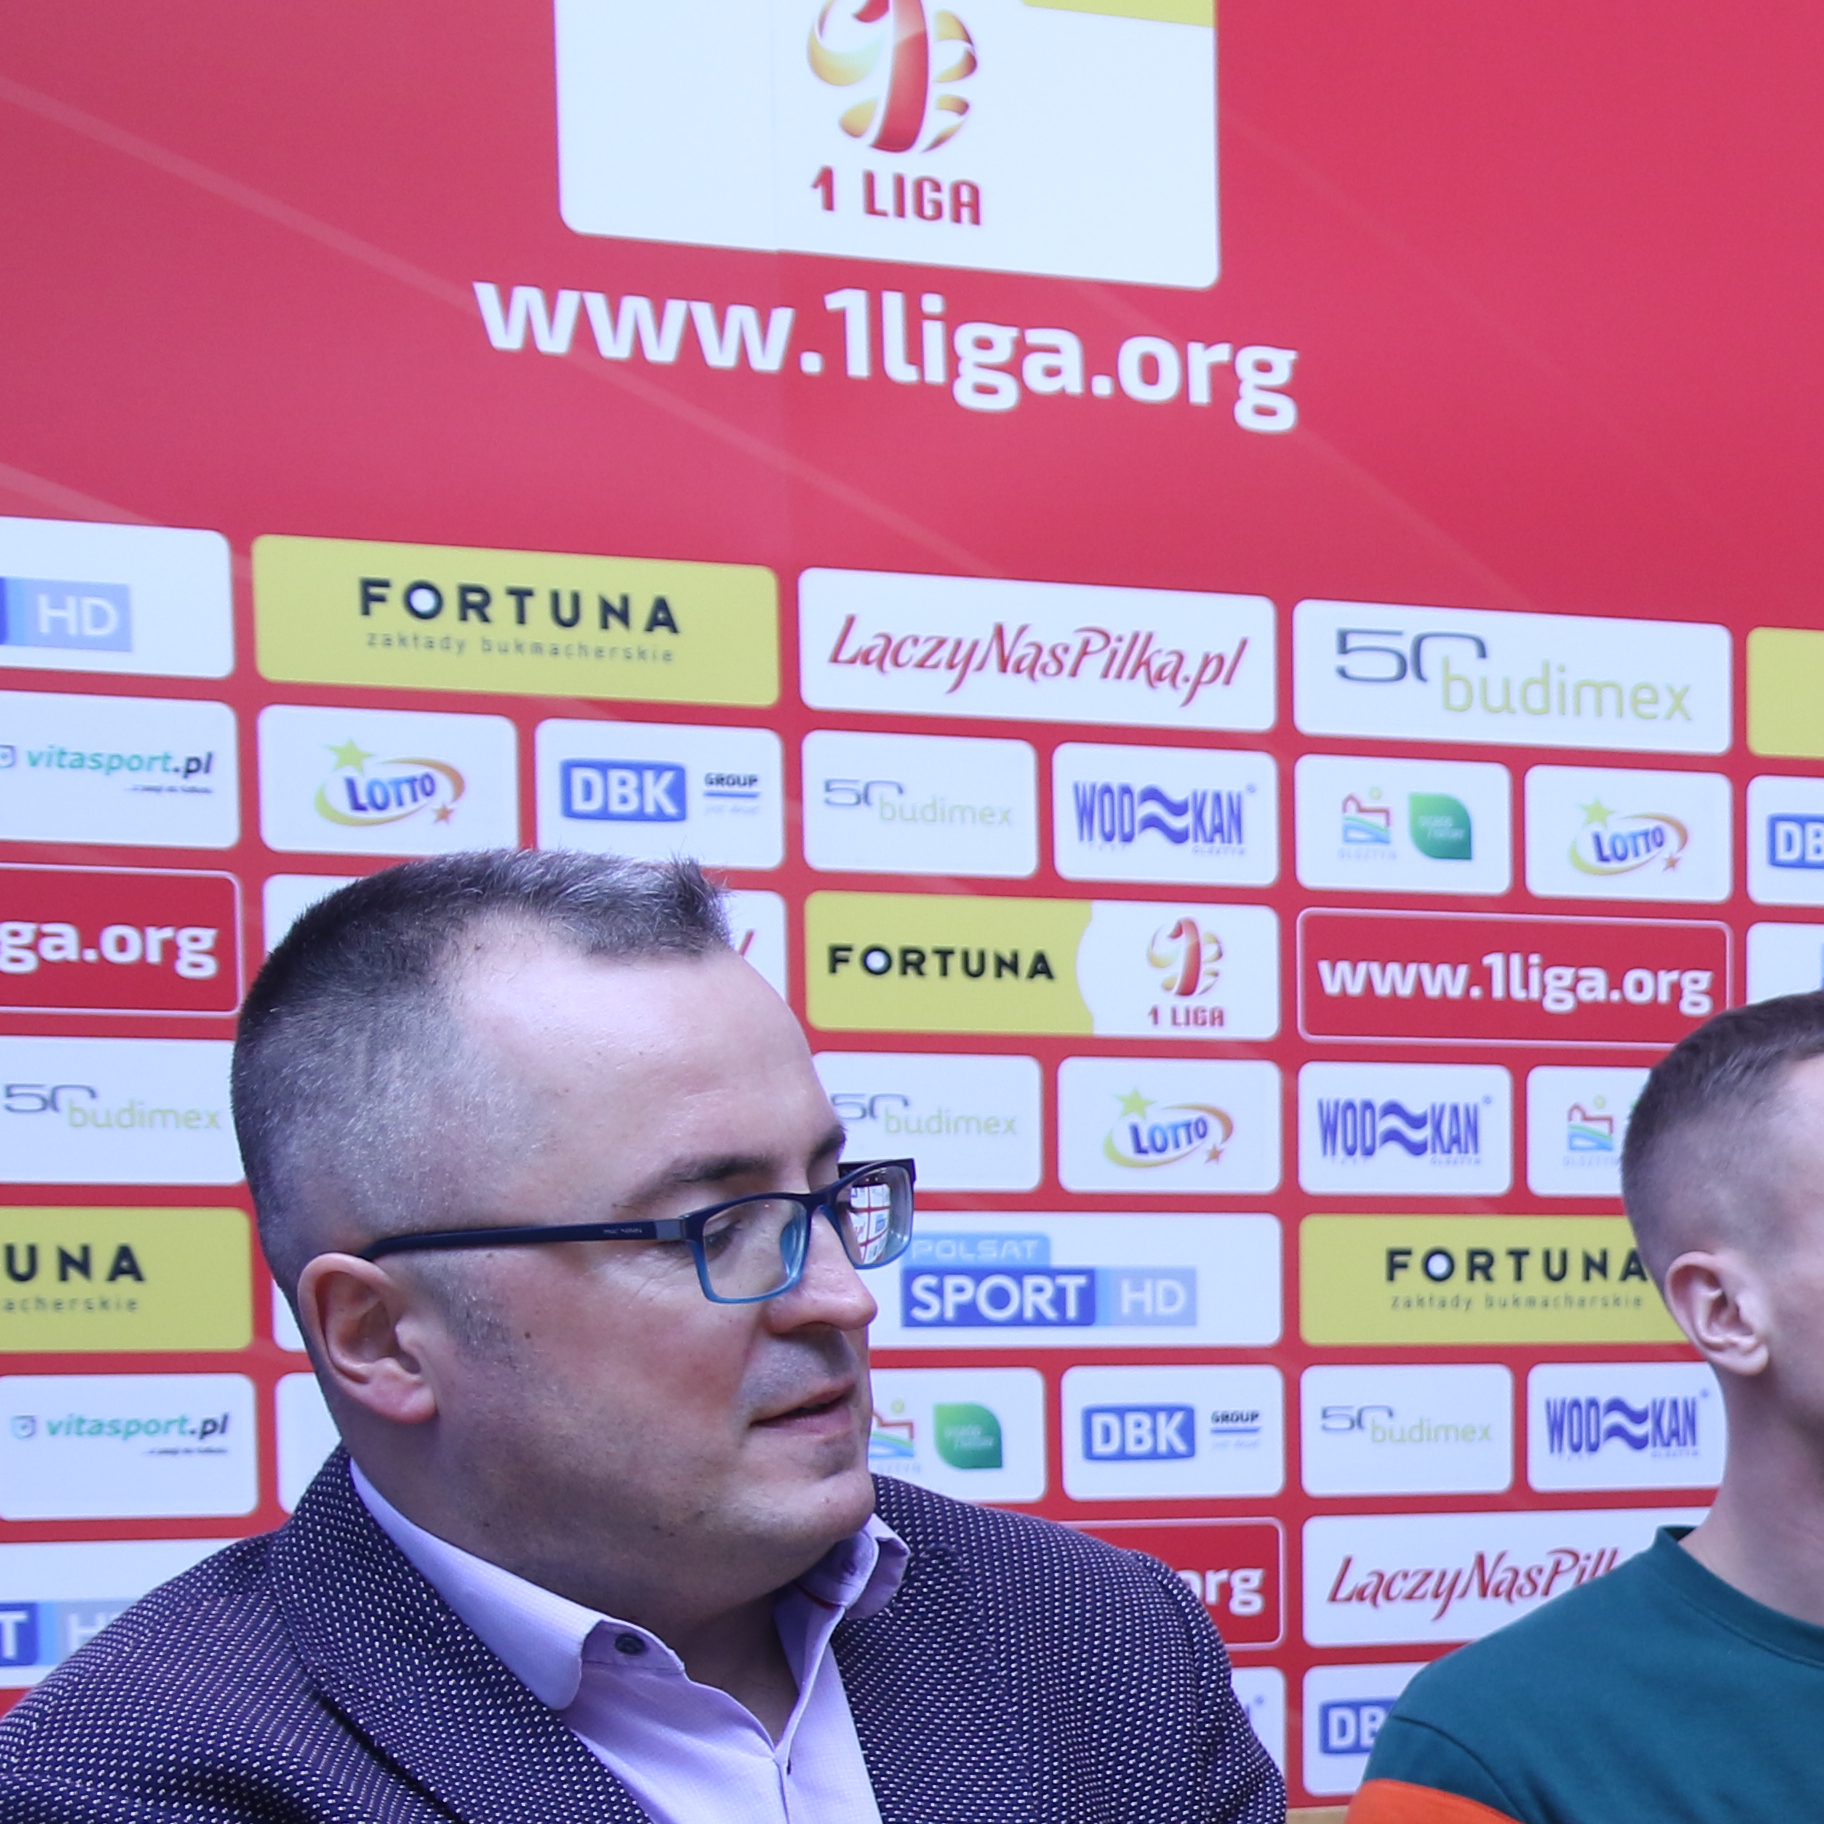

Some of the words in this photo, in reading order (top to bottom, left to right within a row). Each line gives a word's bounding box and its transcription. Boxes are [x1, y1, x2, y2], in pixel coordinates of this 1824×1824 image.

[811, 166, 835, 211] 1
[864, 172, 981, 226] LIGA
[473, 280, 1297, 431] www.1liga.org
[359, 577, 681, 636] FORTUNA
[1442, 656, 1692, 720] budimex
[25, 744, 212, 779] vitasport.pl
[345, 771, 437, 814] LOTTO
[571, 766, 679, 816] DBK
[704, 772, 758, 789] GROUP
[880, 792, 1011, 825] budimex
[1592, 826, 1665, 862] LOTTO
[829, 945, 1054, 980] FORTUNA
[1318, 952, 1713, 1017] www.1liga.org
[1148, 1005, 1160, 1026] 1
[1172, 1007, 1224, 1027] LIGA
[68, 1098, 222, 1128] budimex
[1129, 1115, 1207, 1155] LOTTO
[911, 1240, 1038, 1259] POLSAT
[1386, 1248, 1649, 1283] FORTUNA
[910, 1275, 1086, 1321] SPORT
[1121, 1281, 1185, 1315] HD
[46, 1414, 229, 1439] vitasport.pl
[1091, 1412, 1186, 1454] DBK
[1211, 1411, 1259, 1425] GROUP
